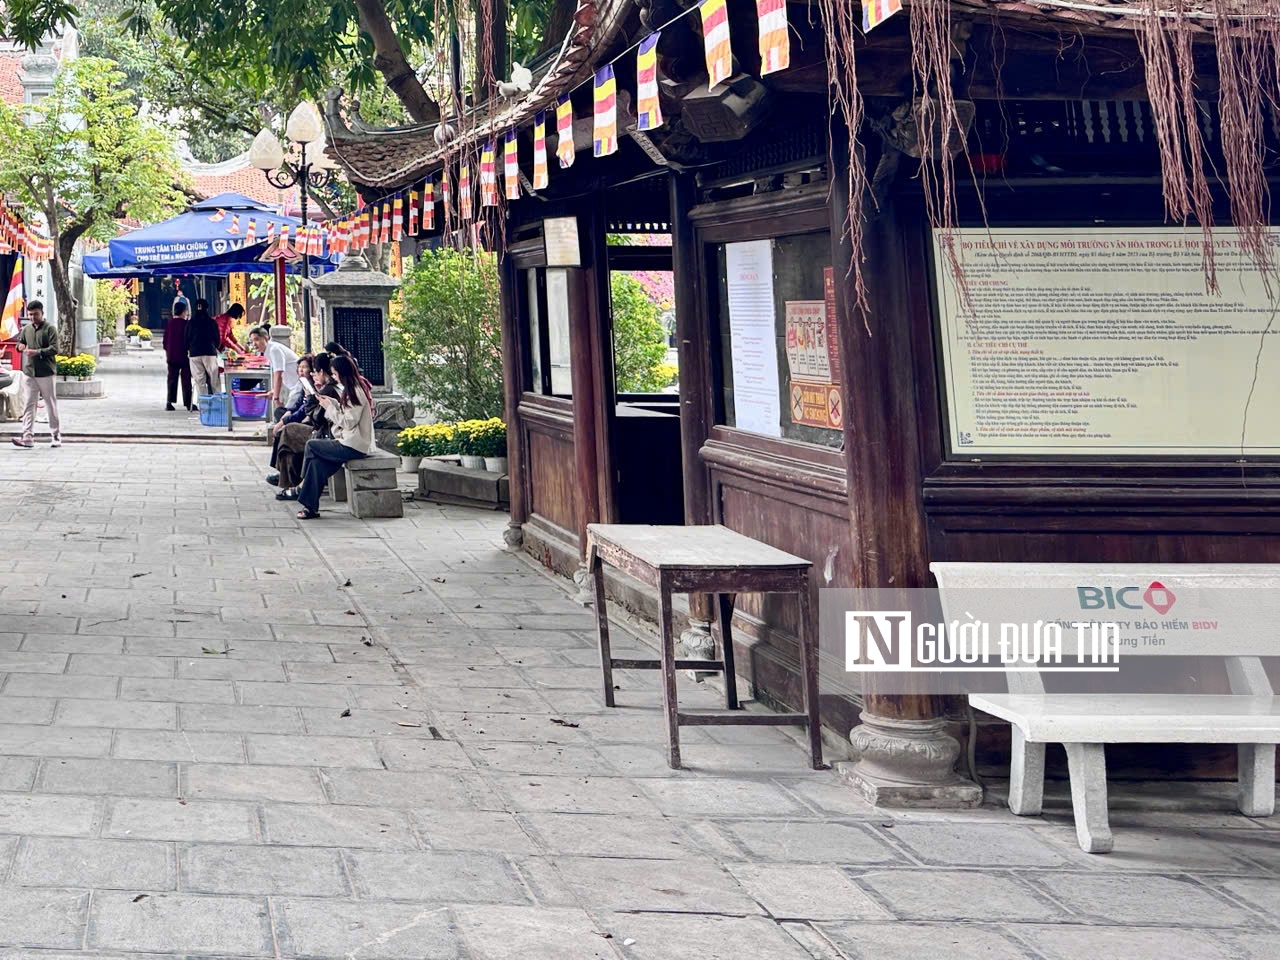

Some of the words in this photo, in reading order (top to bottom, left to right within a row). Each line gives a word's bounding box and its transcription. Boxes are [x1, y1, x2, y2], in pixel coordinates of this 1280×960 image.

[135, 246, 156, 254] TRUNG
[170, 242, 185, 252] TIÊM
[1146, 241, 1173, 249] TRONG
[1134, 619, 1159, 630] BẢO
[1192, 621, 1219, 630] BIDV
[1141, 634, 1166, 646] Tiến
